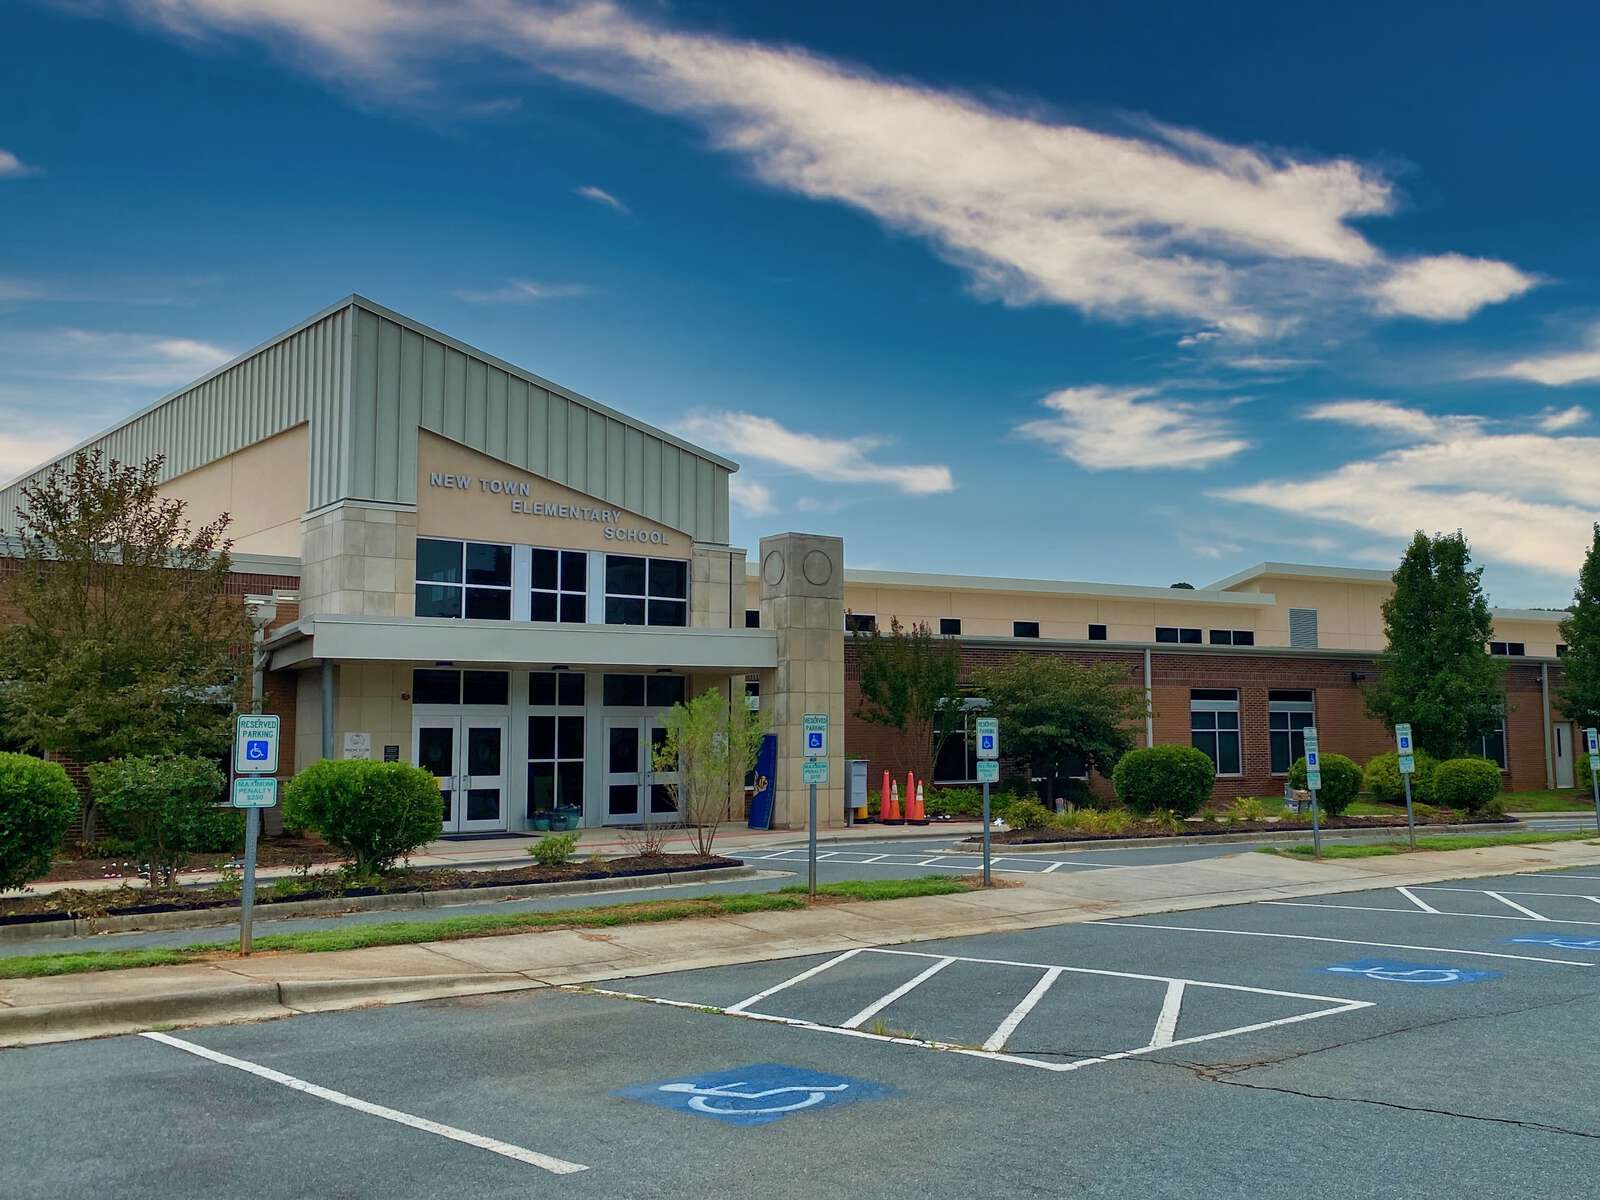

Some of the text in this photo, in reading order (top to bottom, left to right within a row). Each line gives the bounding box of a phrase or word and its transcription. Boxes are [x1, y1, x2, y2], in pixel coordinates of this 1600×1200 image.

[430, 471, 530, 498] NEW TOWN
[511, 499, 622, 524] ELEMENTARY
[604, 526, 669, 546] SCHOOL
[240, 720, 277, 729] RESERVED
[242, 730, 273, 738] PARKING
